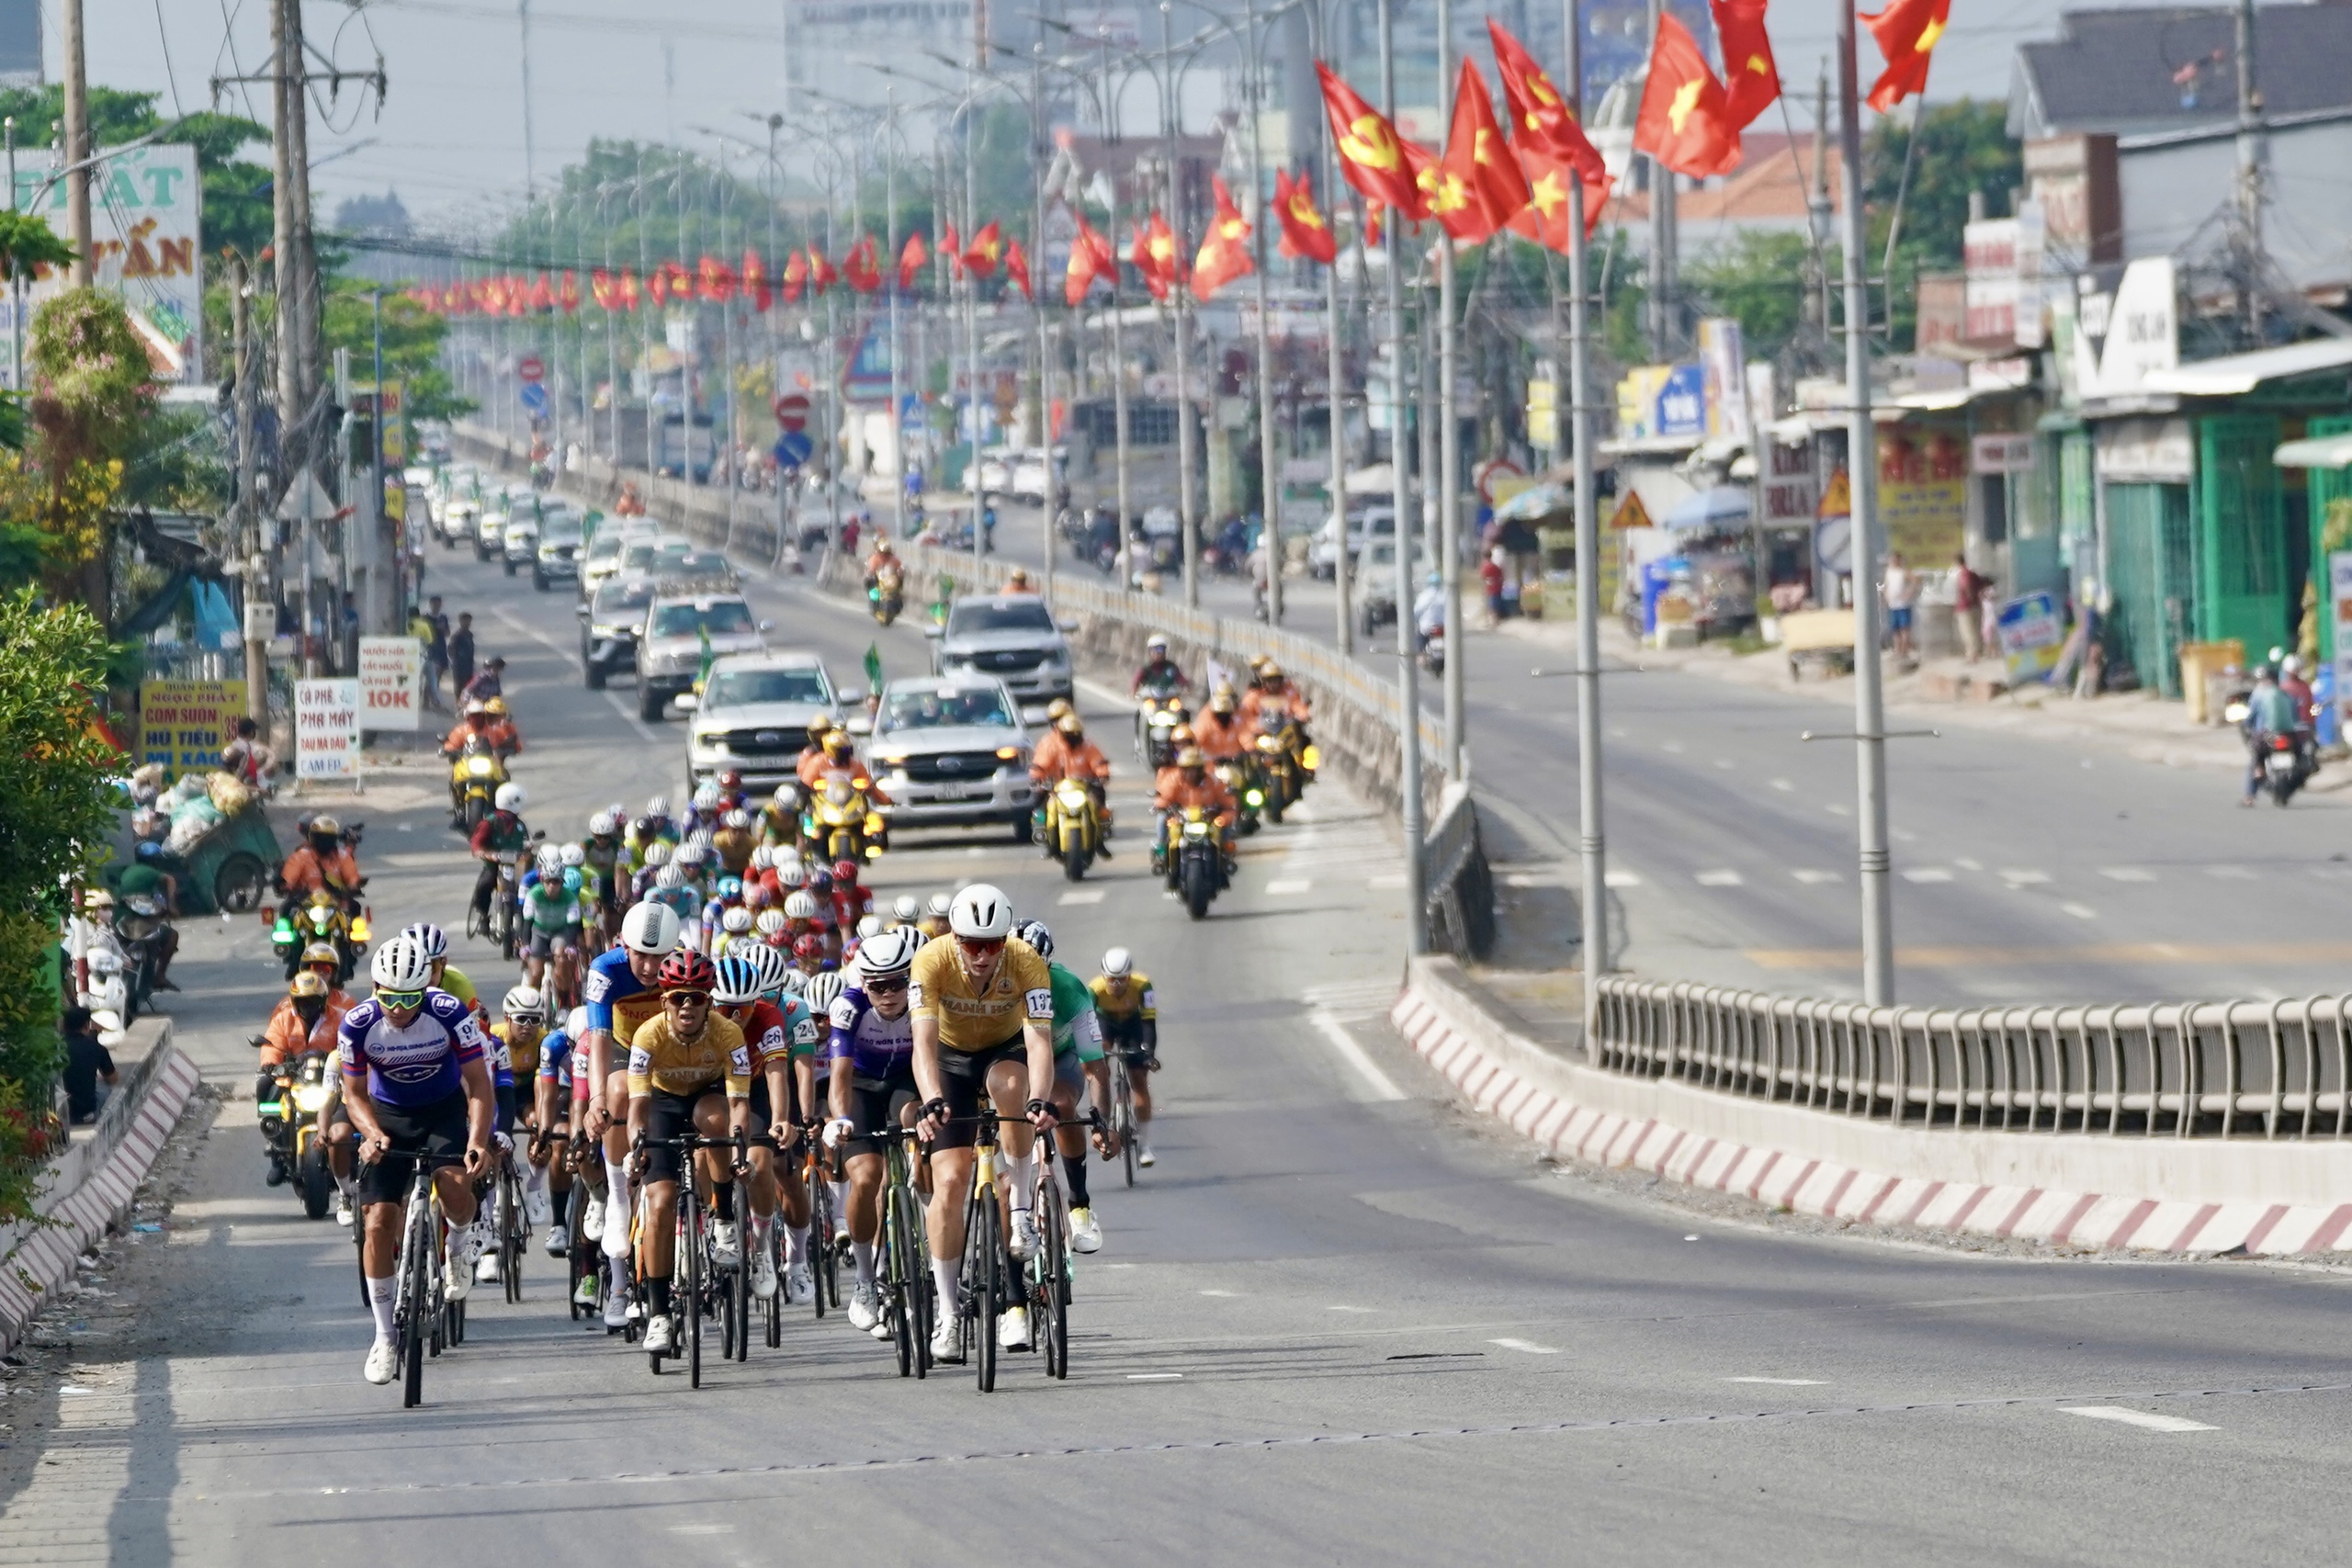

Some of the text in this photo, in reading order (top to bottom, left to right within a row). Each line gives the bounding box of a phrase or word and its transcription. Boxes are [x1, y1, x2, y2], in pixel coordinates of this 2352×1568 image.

[368, 689, 410, 709] 10K
[759, 1030, 781, 1049] 126
[798, 1023, 816, 1038] 24
